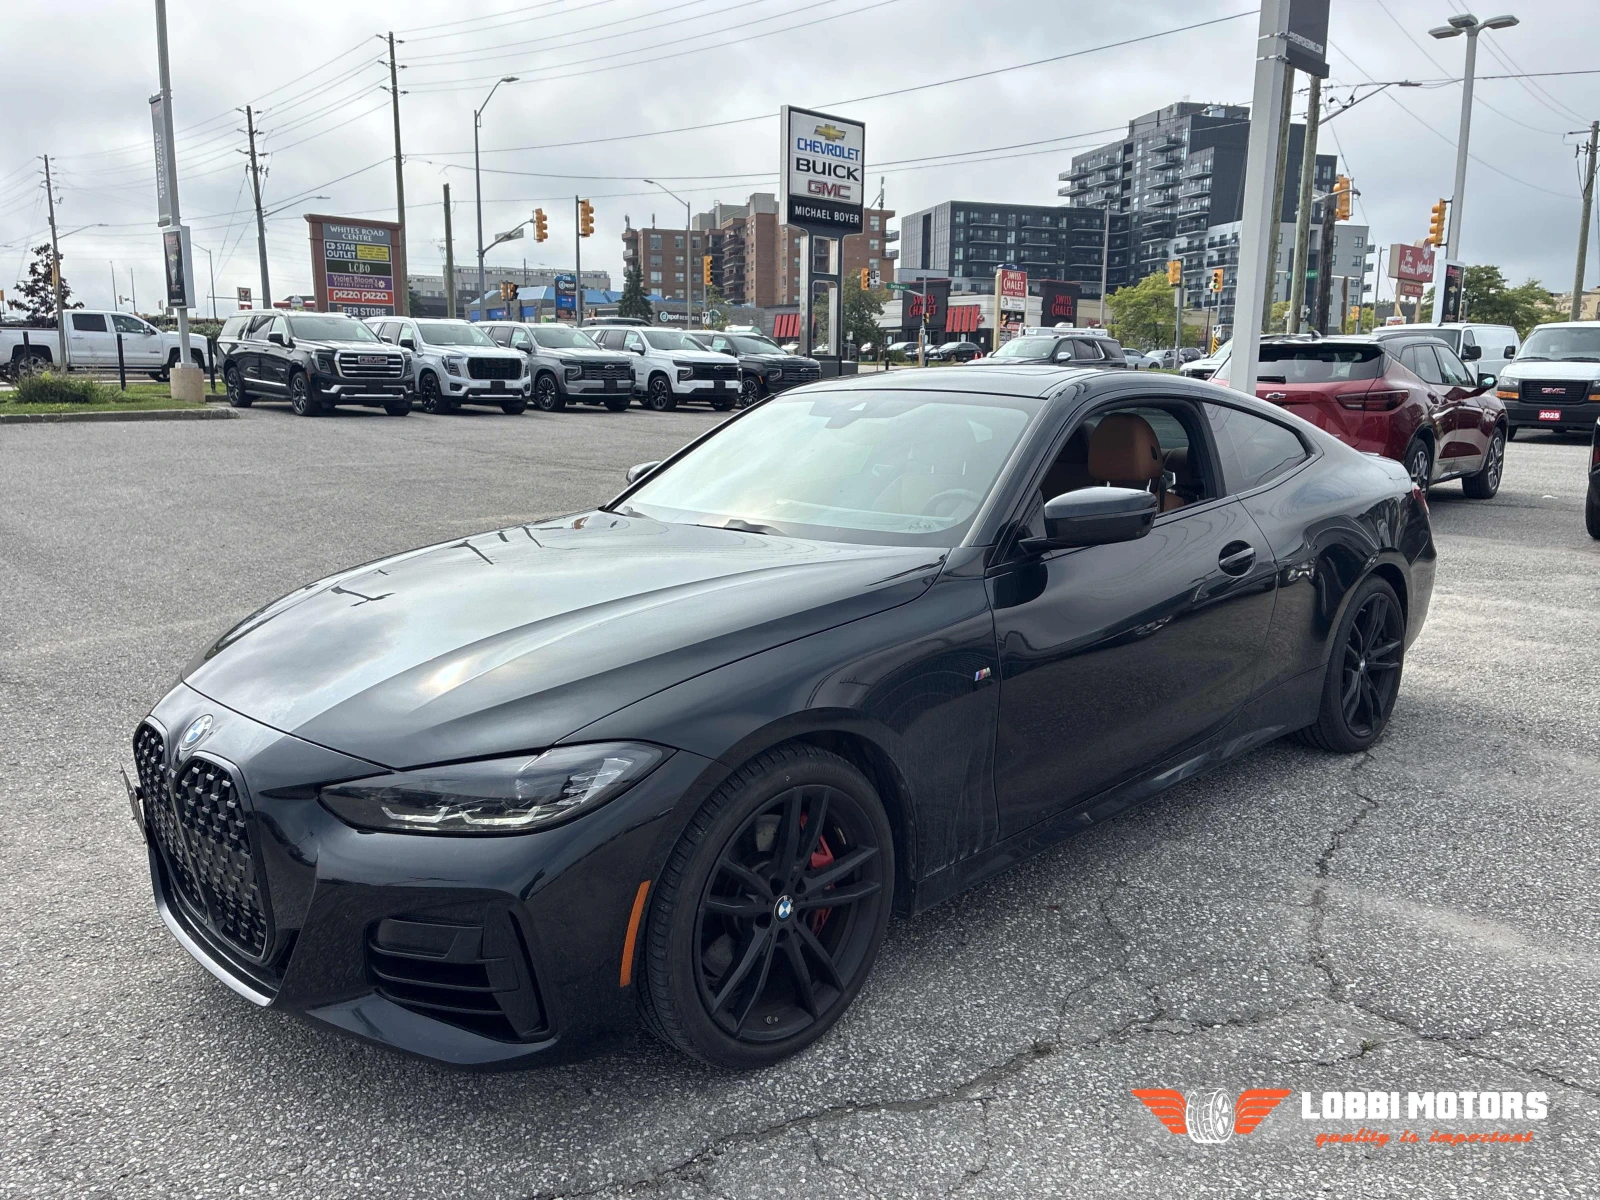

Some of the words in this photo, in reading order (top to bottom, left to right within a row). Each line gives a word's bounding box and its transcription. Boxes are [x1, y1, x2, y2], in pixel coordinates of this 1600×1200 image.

[797, 137, 860, 161] CHEVROLET
[795, 157, 860, 182] BUICK
[807, 179, 851, 200] GMC
[794, 205, 831, 220] MICHAEL
[834, 211, 859, 224] BOYER
[330, 225, 360, 235] WHITES
[361, 228, 384, 237] ROAD
[342, 233, 372, 242] CENTRE
[336, 242, 356, 251] STAR
[326, 250, 356, 259] OUTLET
[348, 262, 370, 273] LCBO
[332, 274, 353, 282] Violet
[353, 275, 377, 284] Bloom's
[1007, 271, 1022, 280] SWISS
[1003, 278, 1024, 290] CHALET
[333, 290, 360, 300] pizza
[361, 291, 388, 302] pizza
[913, 294, 935, 305] SWSS
[1055, 294, 1072, 306] SWISS
[360, 307, 386, 316] STORE
[908, 304, 938, 318] CHAET
[1051, 304, 1073, 316] CHALET
